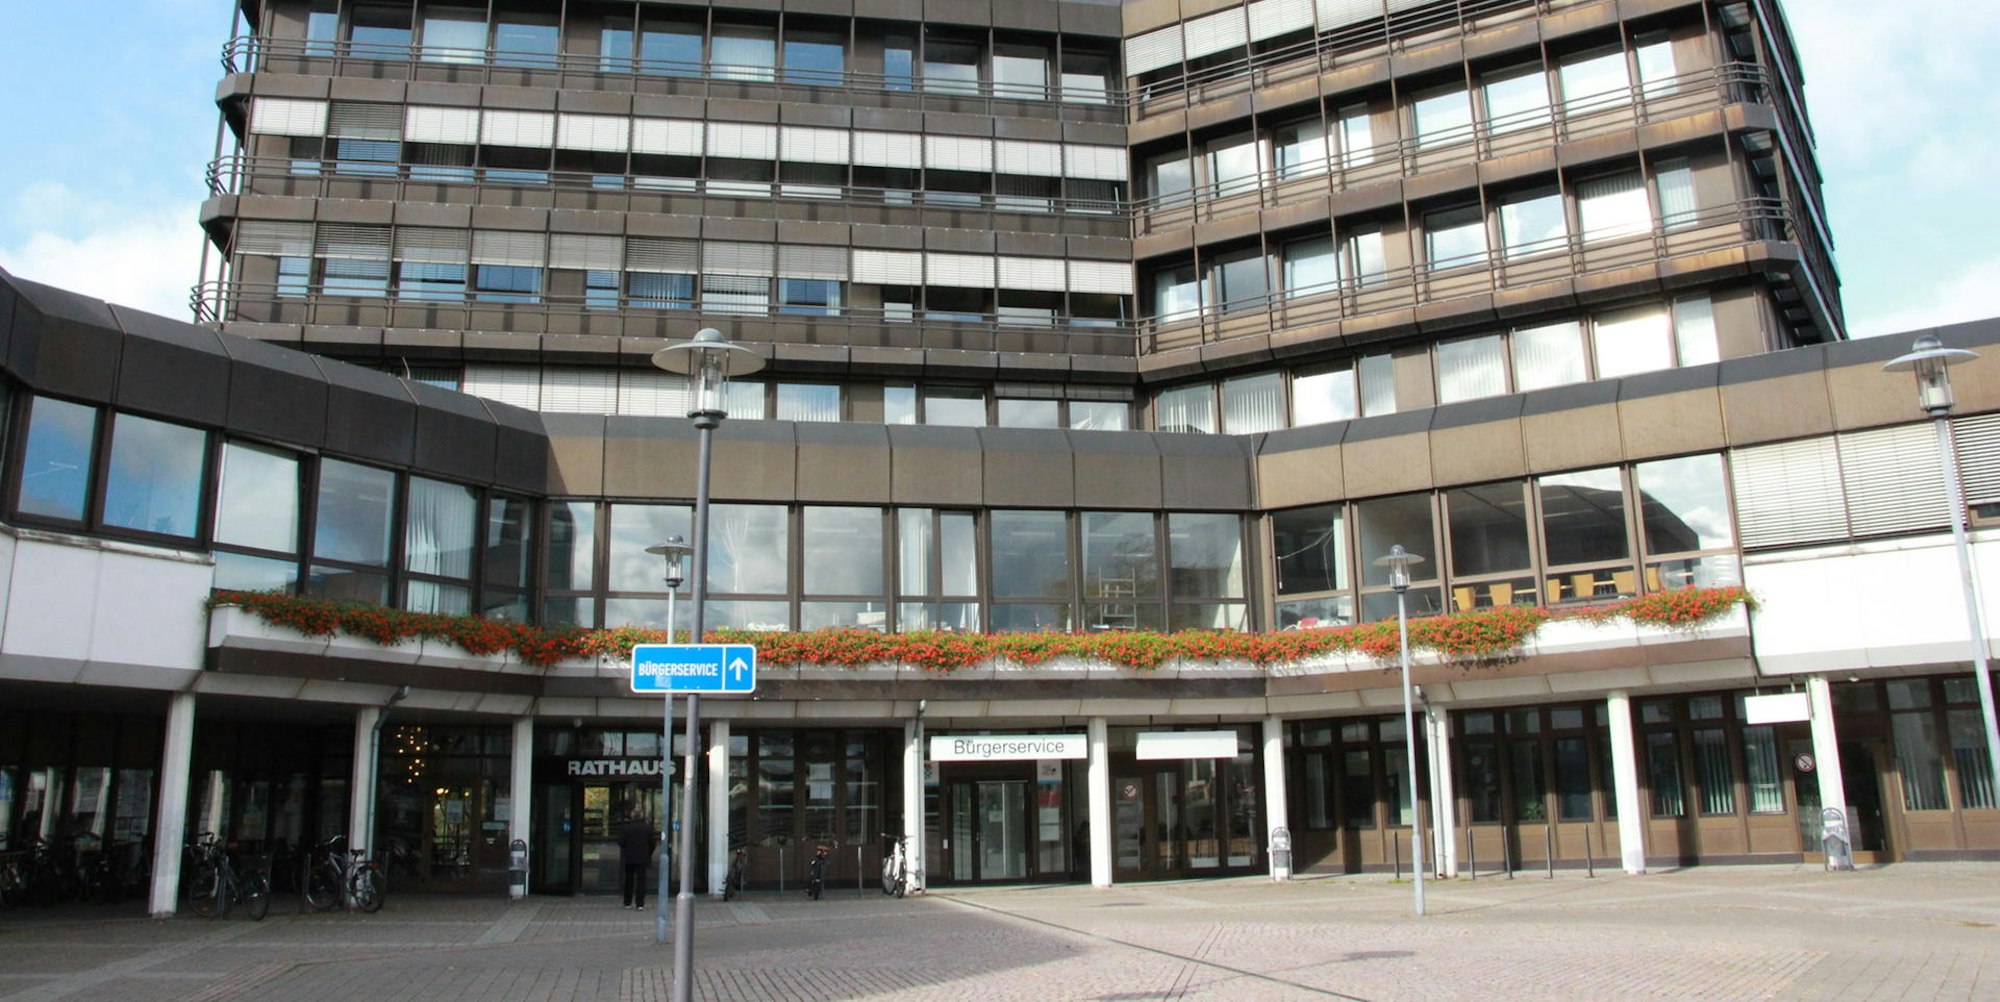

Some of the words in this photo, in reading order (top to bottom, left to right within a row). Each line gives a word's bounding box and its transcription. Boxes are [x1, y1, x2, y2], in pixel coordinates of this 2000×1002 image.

[638, 660, 718, 676] BÜRGERSERVICE
[954, 739, 1064, 757] Bürgerservice
[568, 760, 676, 775] RATHAUS
